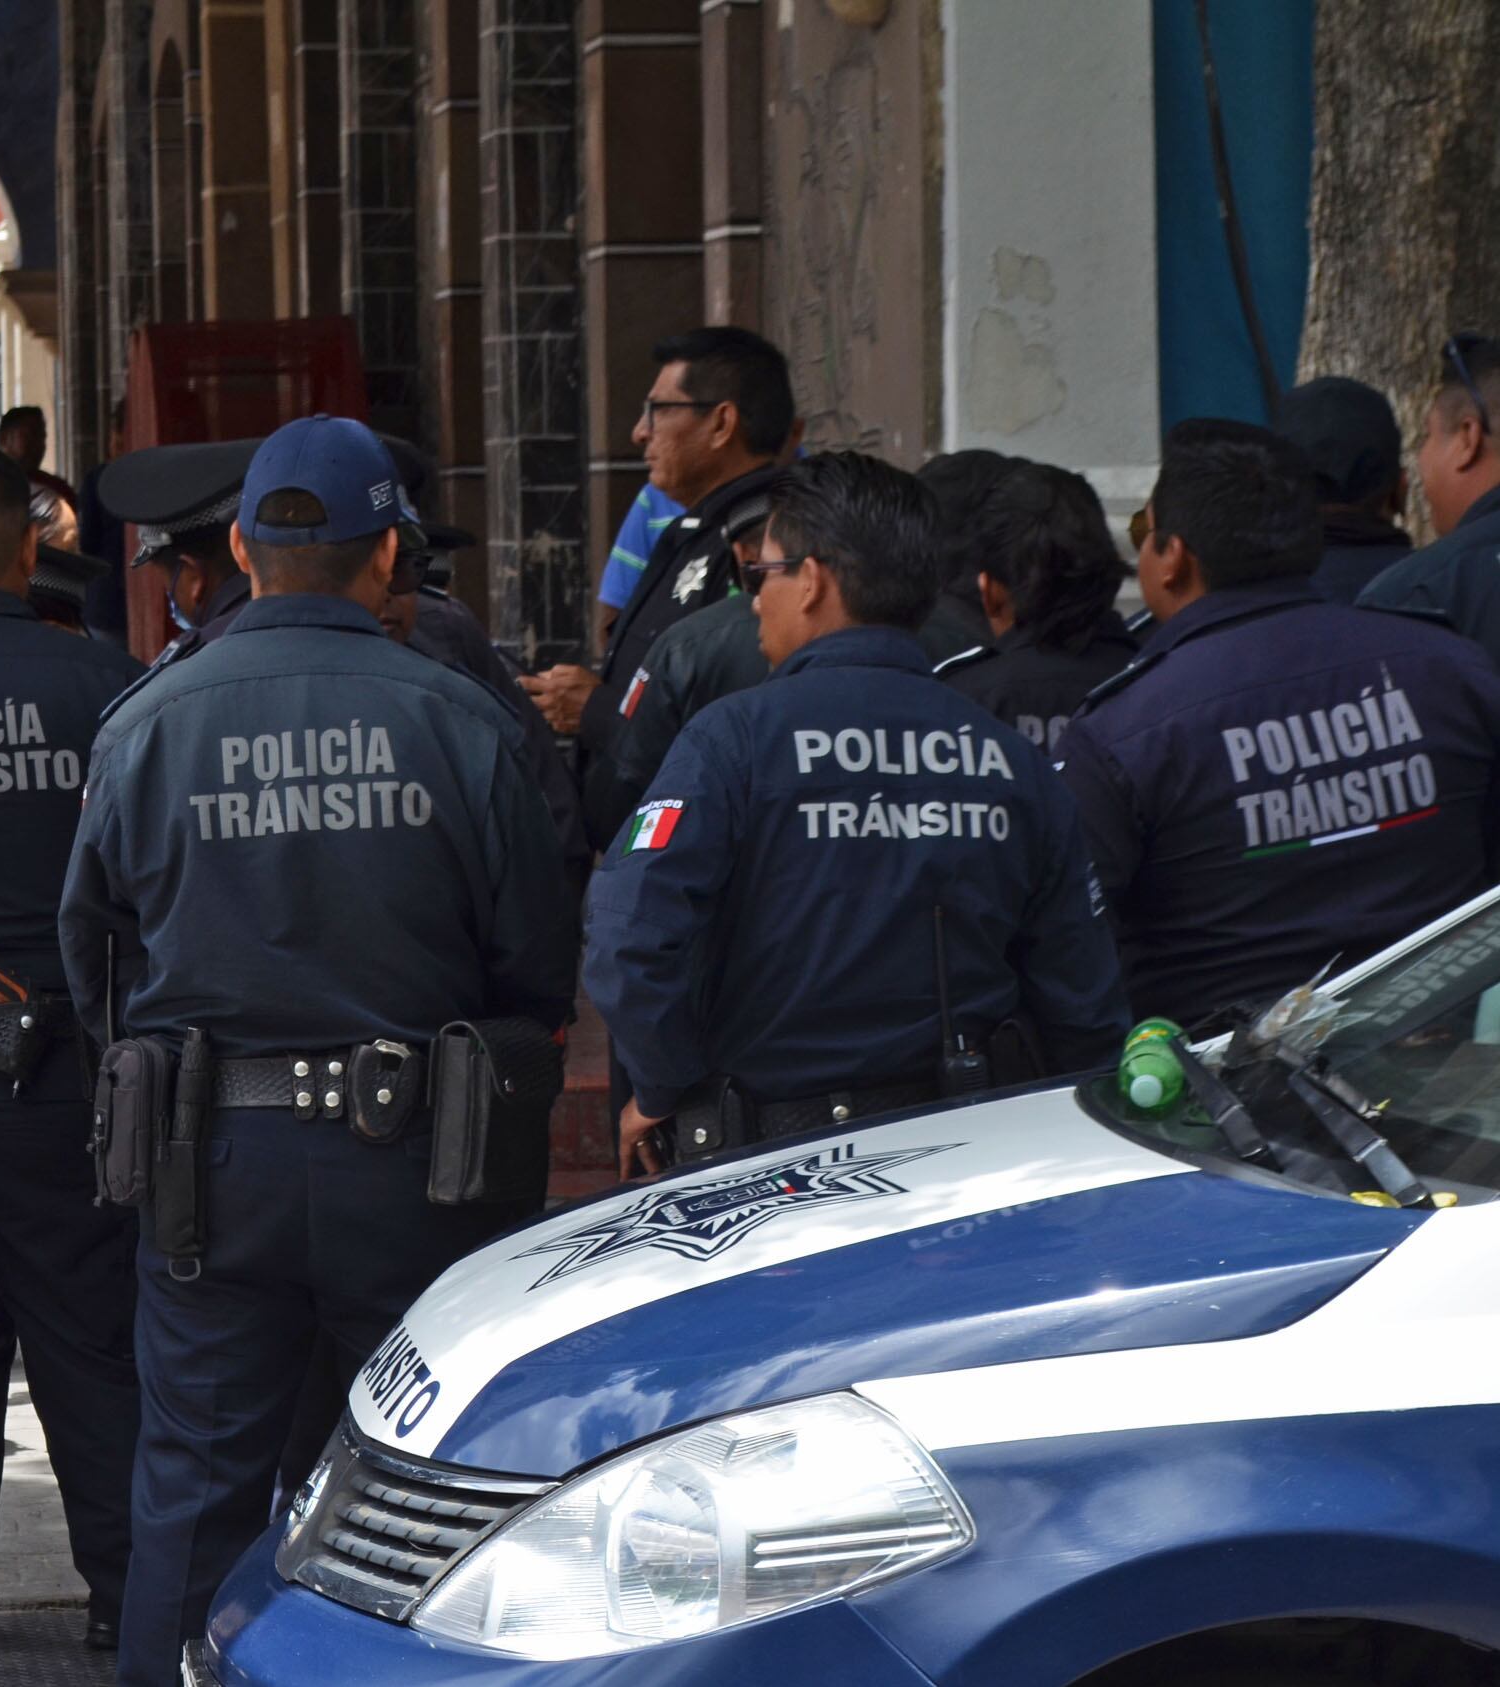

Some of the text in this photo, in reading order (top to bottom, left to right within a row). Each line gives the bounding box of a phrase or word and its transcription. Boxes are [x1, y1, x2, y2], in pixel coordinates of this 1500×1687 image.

[221, 719, 395, 785] POLICÍA
[794, 725, 1015, 781] POLICÍA
[1222, 685, 1422, 783] POLICÍA
[190, 773, 432, 841] TRÁNSITO
[798, 794, 1010, 842] TRÁNSITO
[1237, 754, 1437, 849] TRÁNSITO
[363, 1322, 441, 1439] ANSITO
